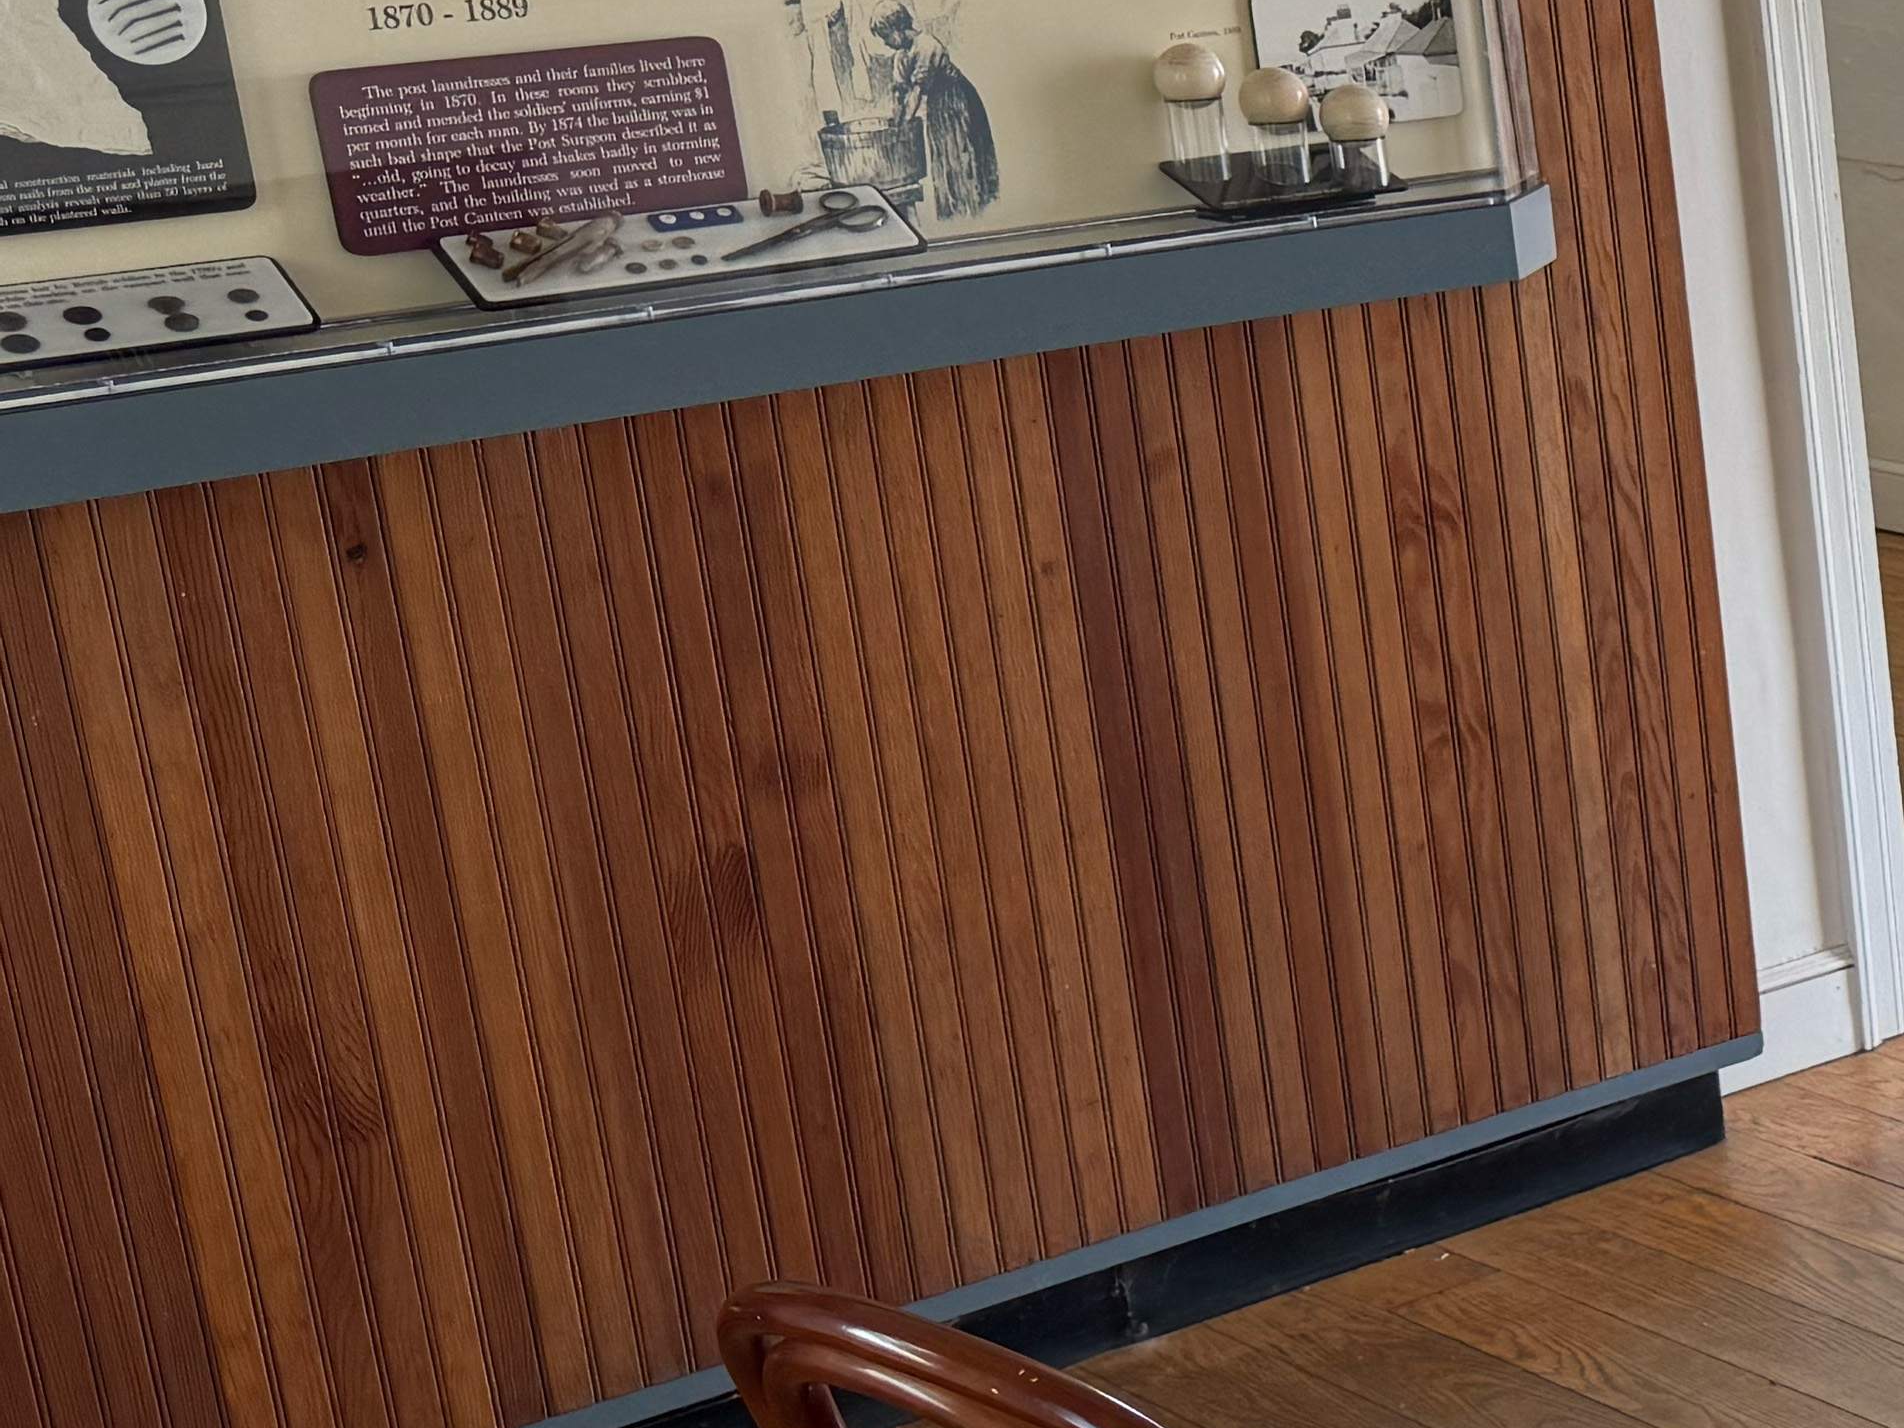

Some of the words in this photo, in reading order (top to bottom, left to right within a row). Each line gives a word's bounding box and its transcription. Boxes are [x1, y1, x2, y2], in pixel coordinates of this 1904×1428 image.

[367, 2, 434, 32] 1870
[339, 102, 412, 119] beginning
[514, 88, 549, 101] these
[558, 85, 599, 97] rooms
[606, 79, 635, 93] they
[643, 71, 706, 87] scrubbed,
[361, 84, 393, 99] The
[397, 83, 427, 99] post
[431, 76, 510, 92] laundresses
[515, 70, 541, 84] and
[546, 67, 577, 81] their
[583, 62, 635, 77] families
[639, 57, 672, 72] lived
[675, 56, 705, 69] here
[343, 119, 389, 136] ironed
[395, 115, 422, 130] and
[426, 109, 483, 127] mended
[487, 107, 509, 121] the
[640, 91, 691, 104] earning
[346, 142, 372, 156] per
[375, 133, 422, 149] month
[426, 131, 446, 145] for
[450, 126, 483, 141] each
[487, 126, 522, 138] man.
[586, 114, 608, 127] the
[611, 109, 668, 125] building
[671, 108, 696, 117] was
[349, 154, 382, 169] such
[387, 150, 415, 165] bad
[420, 148, 461, 163] shape
[466, 143, 494, 156] that
[500, 140, 522, 153] the
[527, 137, 555, 150] Post
[561, 132, 616, 146] Surgeon
[621, 122, 683, 139] described
[411, 166, 451, 183] going
[475, 159, 515, 173] decay
[521, 153, 547, 168] and
[552, 149, 595, 164] shakes
[600, 144, 638, 159] badly
[661, 136, 720, 151] storming
[359, 205, 423, 223] quarters,
[431, 197, 458, 212] and
[464, 195, 486, 208] the
[492, 188, 551, 204] building
[556, 187, 582, 197] was
[588, 179, 618, 193] used
[657, 169, 724, 184] storehouse
[439, 180, 469, 194] The
[481, 172, 558, 189] laundresses
[570, 168, 600, 178] soon
[612, 158, 657, 174] moved
[694, 155, 720, 165] new
[363, 221, 396, 237] until
[402, 219, 425, 232] the
[429, 215, 458, 229] Post
[464, 209, 522, 224] Canteen
[527, 207, 554, 217] was
[558, 194, 634, 212] established.
